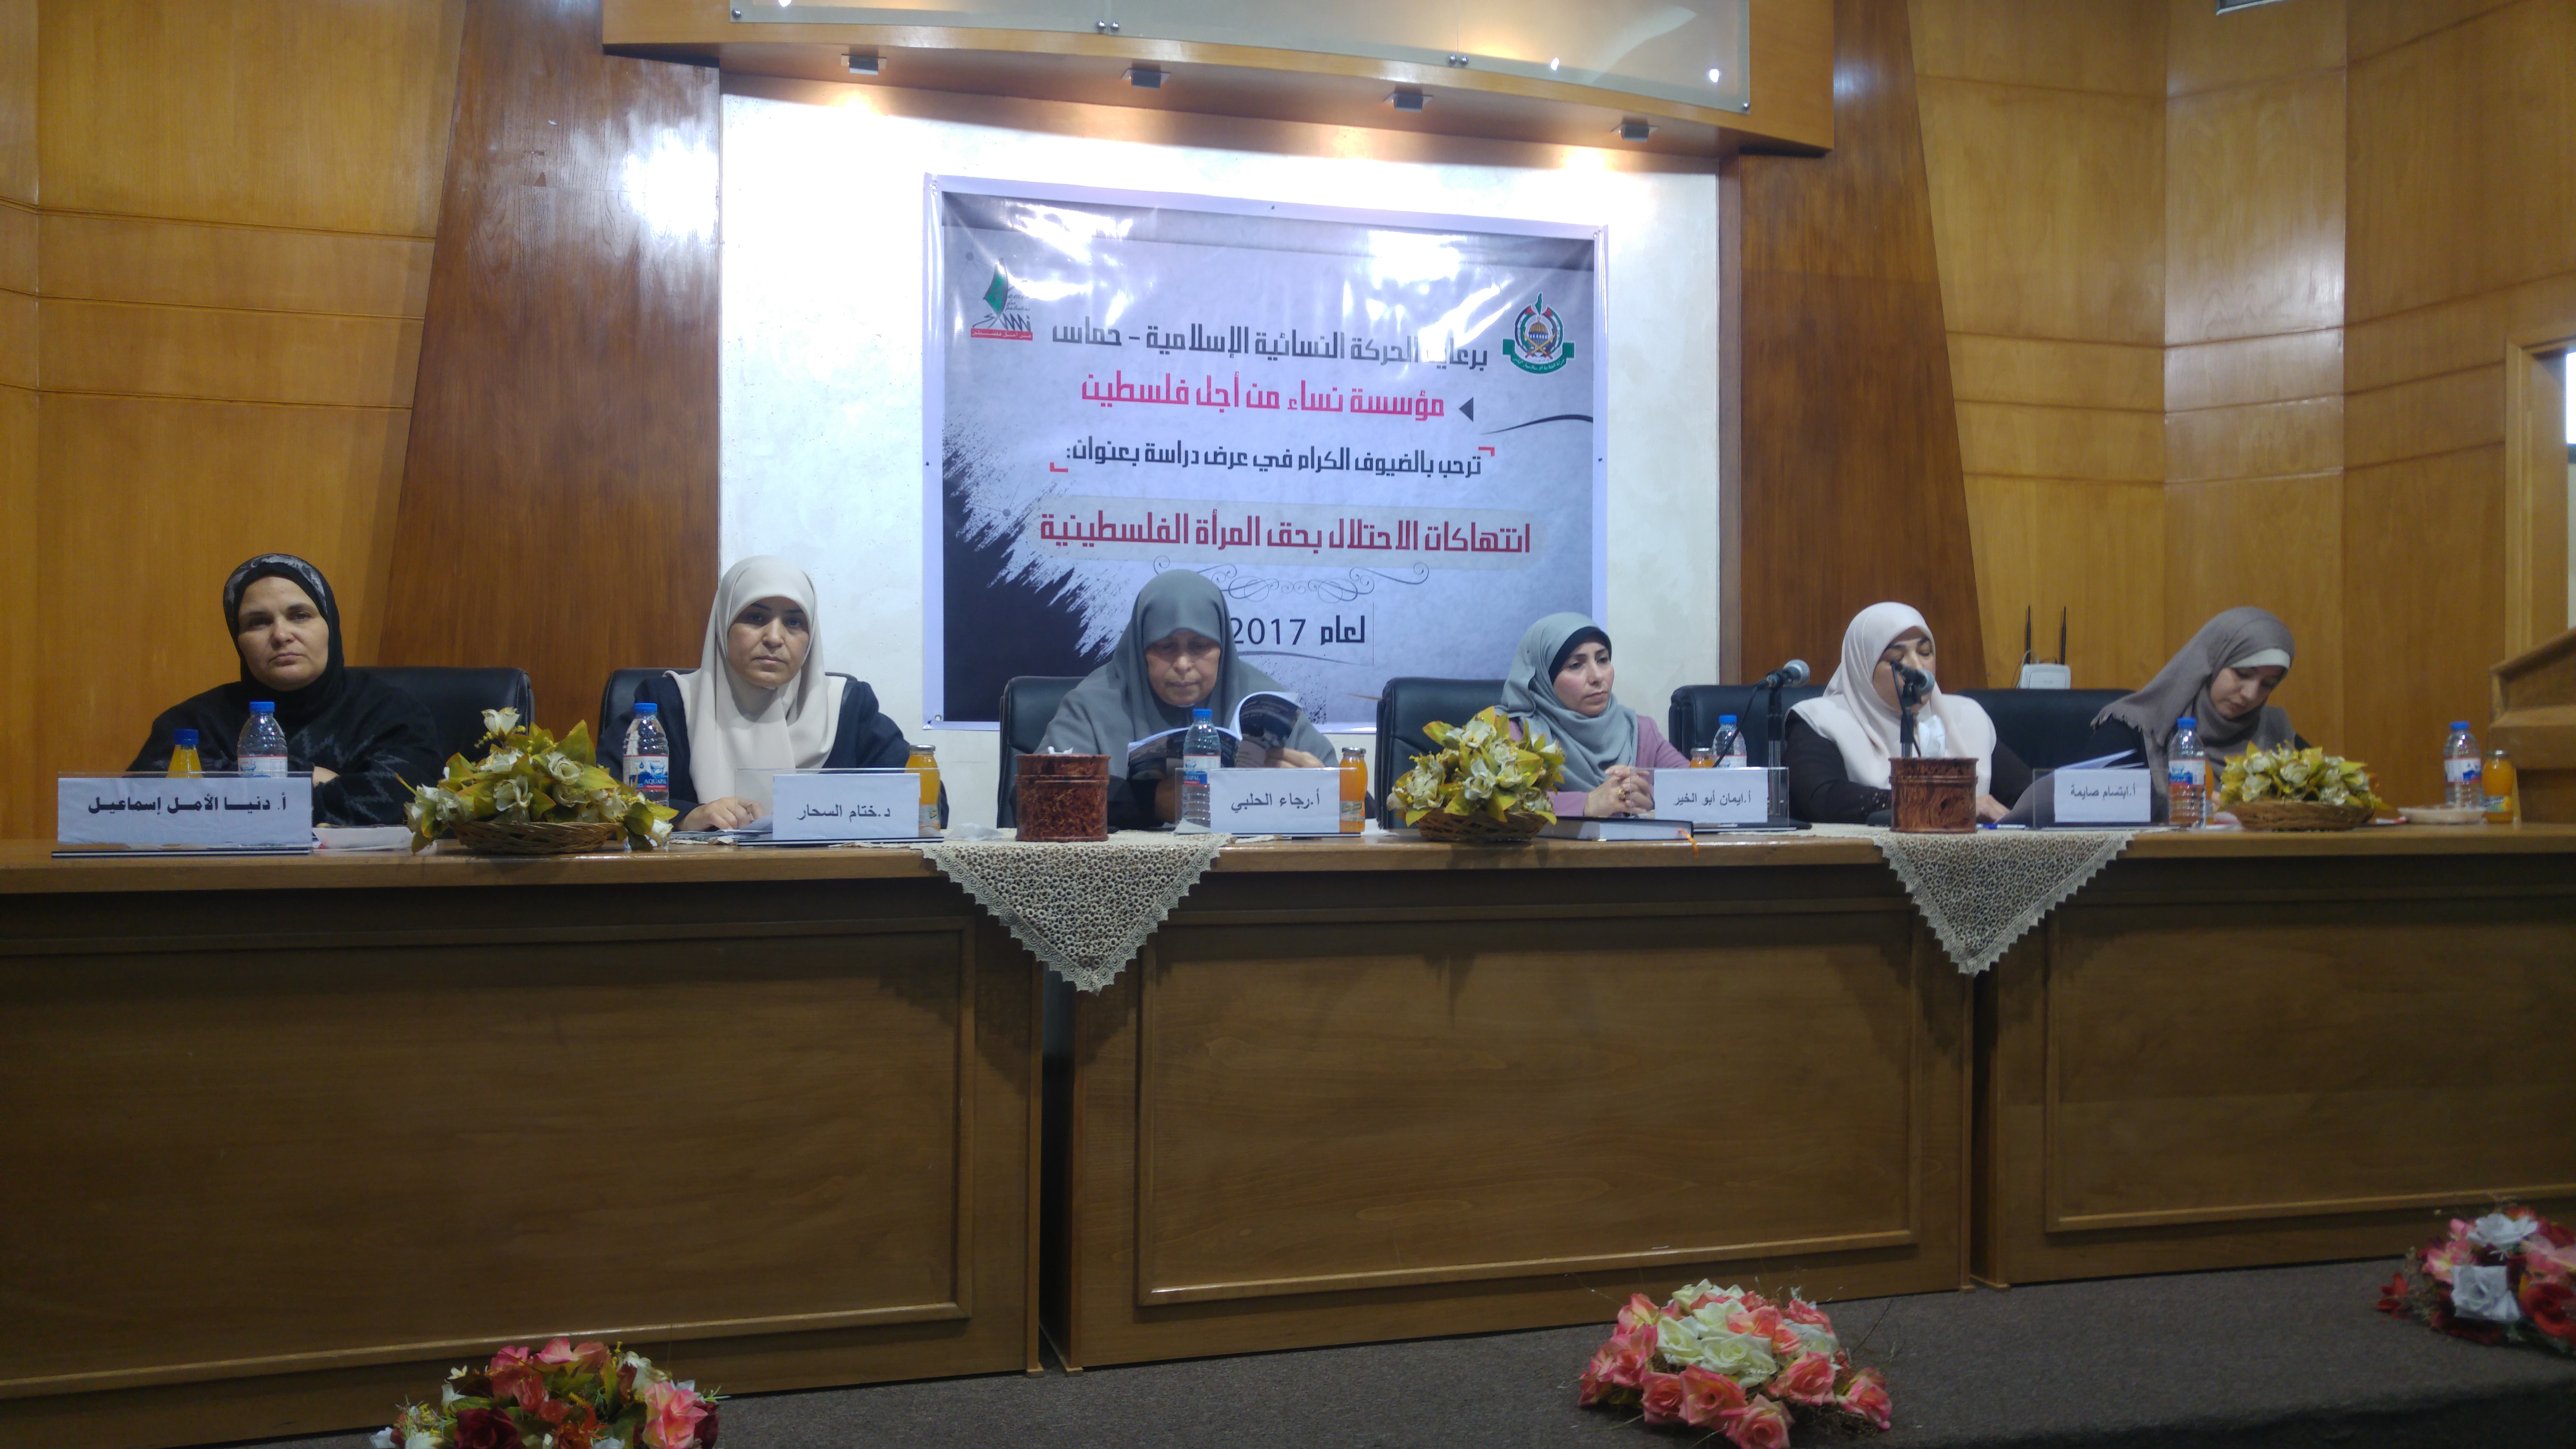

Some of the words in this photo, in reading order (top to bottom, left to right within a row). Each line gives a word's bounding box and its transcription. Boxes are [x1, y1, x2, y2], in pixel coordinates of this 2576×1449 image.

[1052, 316, 1122, 347] حماس
[1146, 323, 1249, 358] الإسلامية
[1255, 329, 1345, 361] النسائية
[1350, 336, 1419, 366] الحركة
[1424, 337, 1488, 372] برعاي
[1082, 370, 1189, 407] فلسطين
[1196, 371, 1240, 413] أجل
[1246, 383, 1280, 409] من
[1287, 380, 1343, 412] نساء
[1350, 388, 1445, 421] مؤسسة
[1145, 439, 1200, 468] دراسة
[1204, 446, 1248, 470] عرض
[1253, 449, 1293, 472] في
[1298, 445, 1351, 473] الكرام
[1354, 449, 1434, 478] بالضيوف
[1438, 455, 1481, 478] ترحب
[1040, 510, 1189, 547] الفلسطينية
[1195, 509, 1261, 550] المرأة
[1267, 521, 1322, 554] بحق
[1329, 518, 1418, 550] الاحتلال
[1425, 521, 1530, 553] انتهاكات
[1230, 617, 1306, 646] 2017
[1320, 614, 1366, 645] لعام
[88, 796, 161, 816] إسماعيل
[166, 793, 219, 815] الأمل
[224, 795, 271, 814] دنيا
[797, 803, 843, 821] السحار
[1231, 792, 1273, 814] الحلبي
[1673, 792, 1697, 806] الخير
[1702, 789, 1716, 806] أبو
